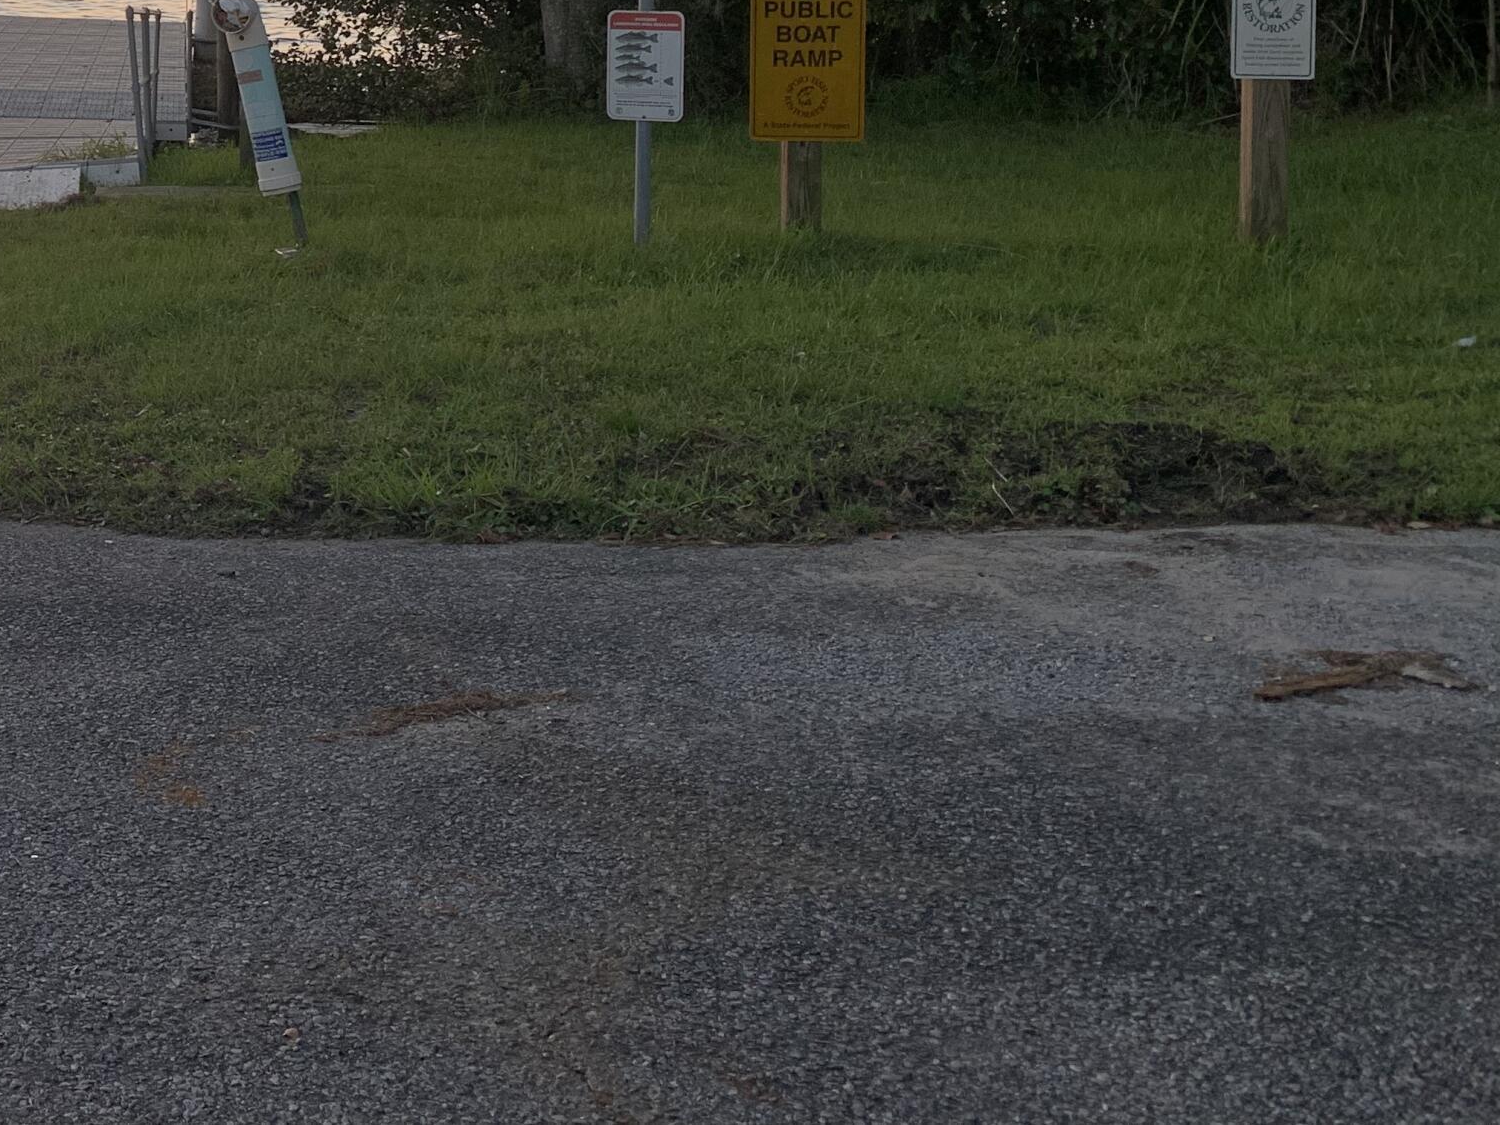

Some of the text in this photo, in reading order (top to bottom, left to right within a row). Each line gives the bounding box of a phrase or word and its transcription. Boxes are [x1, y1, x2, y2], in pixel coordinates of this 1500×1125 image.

[764, 0, 853, 19] PUBLIC
[1243, 3, 1306, 33] RESTORATION
[776, 25, 841, 44] BOAT
[772, 49, 843, 68] RAMP
